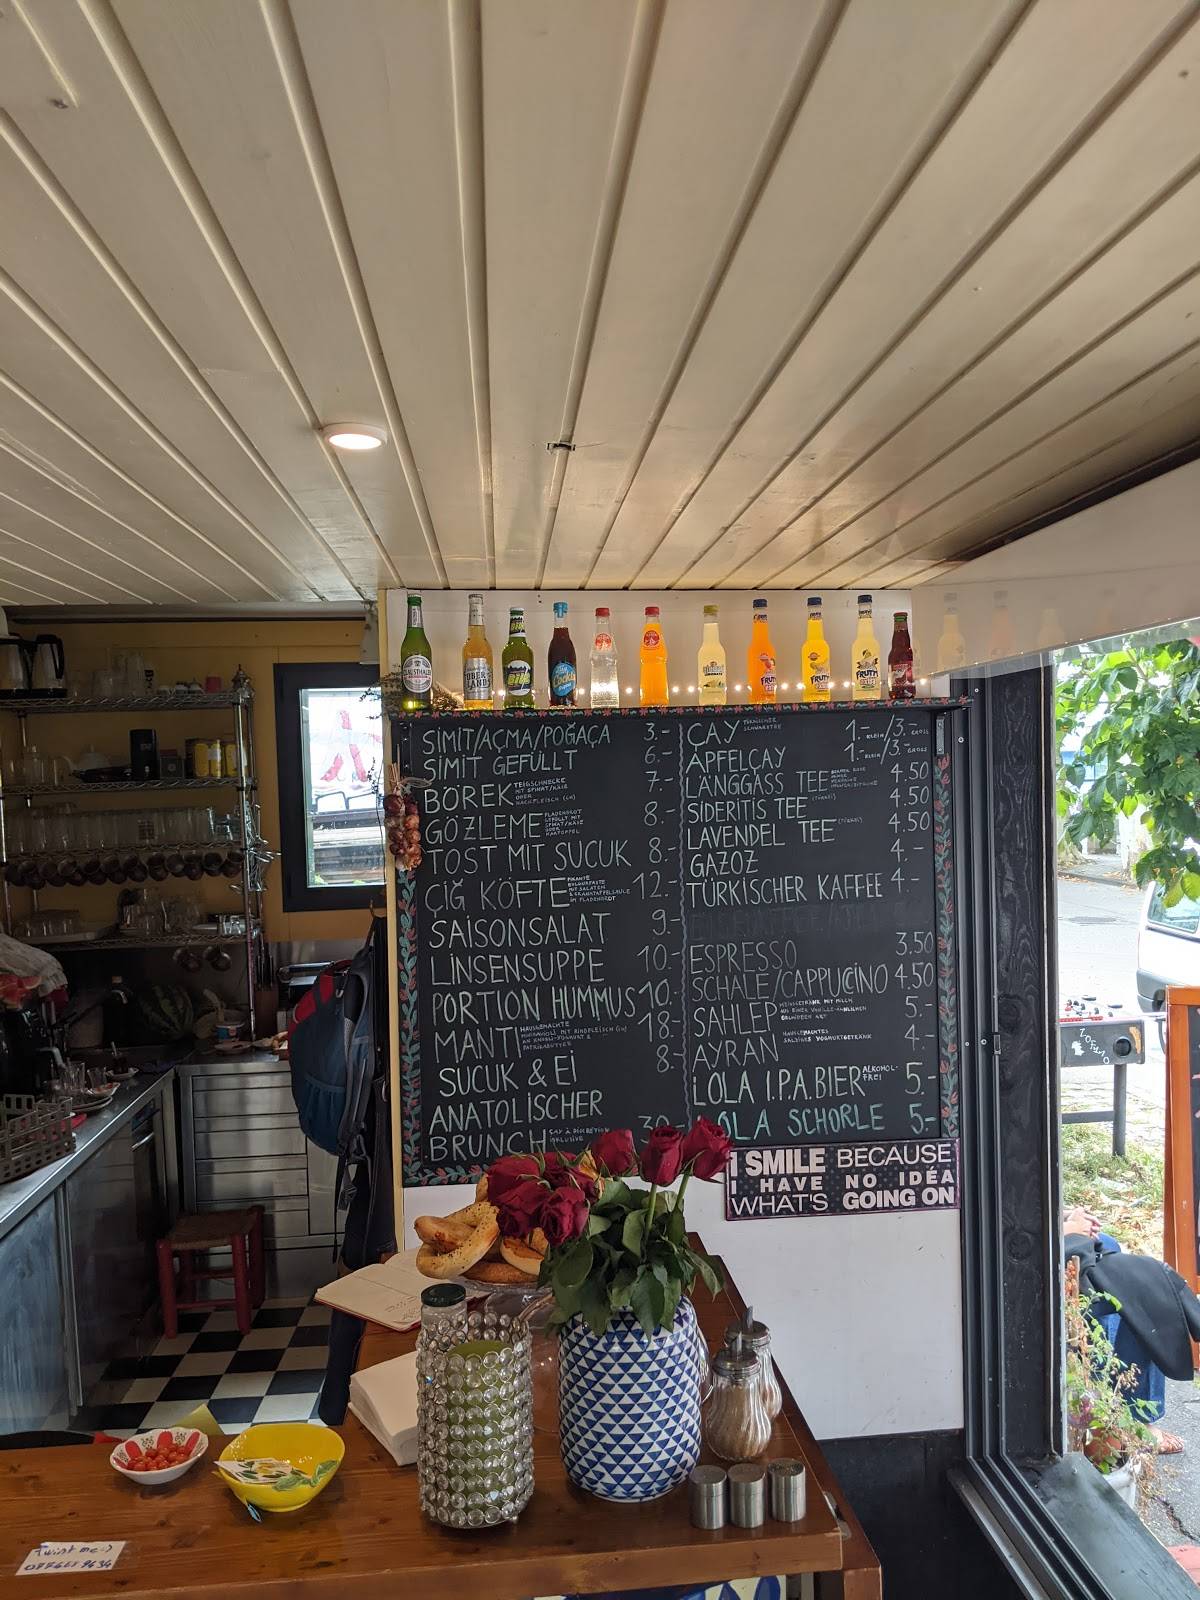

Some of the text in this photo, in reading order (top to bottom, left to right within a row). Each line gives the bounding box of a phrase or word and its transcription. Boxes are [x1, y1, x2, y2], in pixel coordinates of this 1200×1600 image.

[644, 722, 670, 741] 3.-
[687, 719, 740, 752] ÇAY
[492, 749, 578, 776] GEFÜLLT
[644, 745, 673, 765] 6.-
[685, 746, 786, 775] APFELÇAY
[424, 770, 674, 814] BÖREK 7.-
[685, 761, 929, 799] LÄNGGASS TEE 4.50
[773, 796, 808, 820] TEE
[889, 785, 930, 808] 4.50
[425, 801, 676, 845] GÖZLEME 8.-
[687, 811, 931, 850] LAVENDEL TEE 4.50
[426, 845, 498, 875] TOST
[553, 839, 632, 871] SUCUK
[648, 836, 677, 864] 8.-
[690, 838, 925, 878] GAZOZ 4.-
[480, 876, 570, 911] KÖFTE
[632, 870, 678, 900] 12.-
[817, 872, 884, 901] KAFFEE
[890, 867, 920, 894] 4.-
[651, 909, 681, 936] 9.-
[636, 943, 681, 973] 10.-
[690, 931, 934, 975] ESPRESSO 3.50
[894, 961, 934, 990] 4.50
[432, 986, 541, 1027] PORTION
[551, 985, 636, 1021] HUMMUS
[693, 995, 933, 1037] SAHLEP 5.-
[434, 1010, 681, 1064] MANTI 18.-
[692, 1023, 935, 1073] AYRAN 4.-
[439, 1062, 520, 1097] SUCUK
[527, 1058, 548, 1088] &
[656, 1044, 684, 1073] 8.-
[692, 1070, 755, 1106] LOLA
[904, 1061, 937, 1095] 5.-
[787, 1103, 886, 1137] SCHORLE
[908, 1102, 937, 1135] 5.-
[428, 1128, 547, 1162] BRUNCH
[730, 1143, 952, 1177] I SMILE BECAUSE
[731, 1180, 737, 1195] I
[760, 1175, 824, 1193] HAVE
[845, 1173, 877, 1189] NO
[731, 1186, 955, 1216] WHAT'S GOING ON
